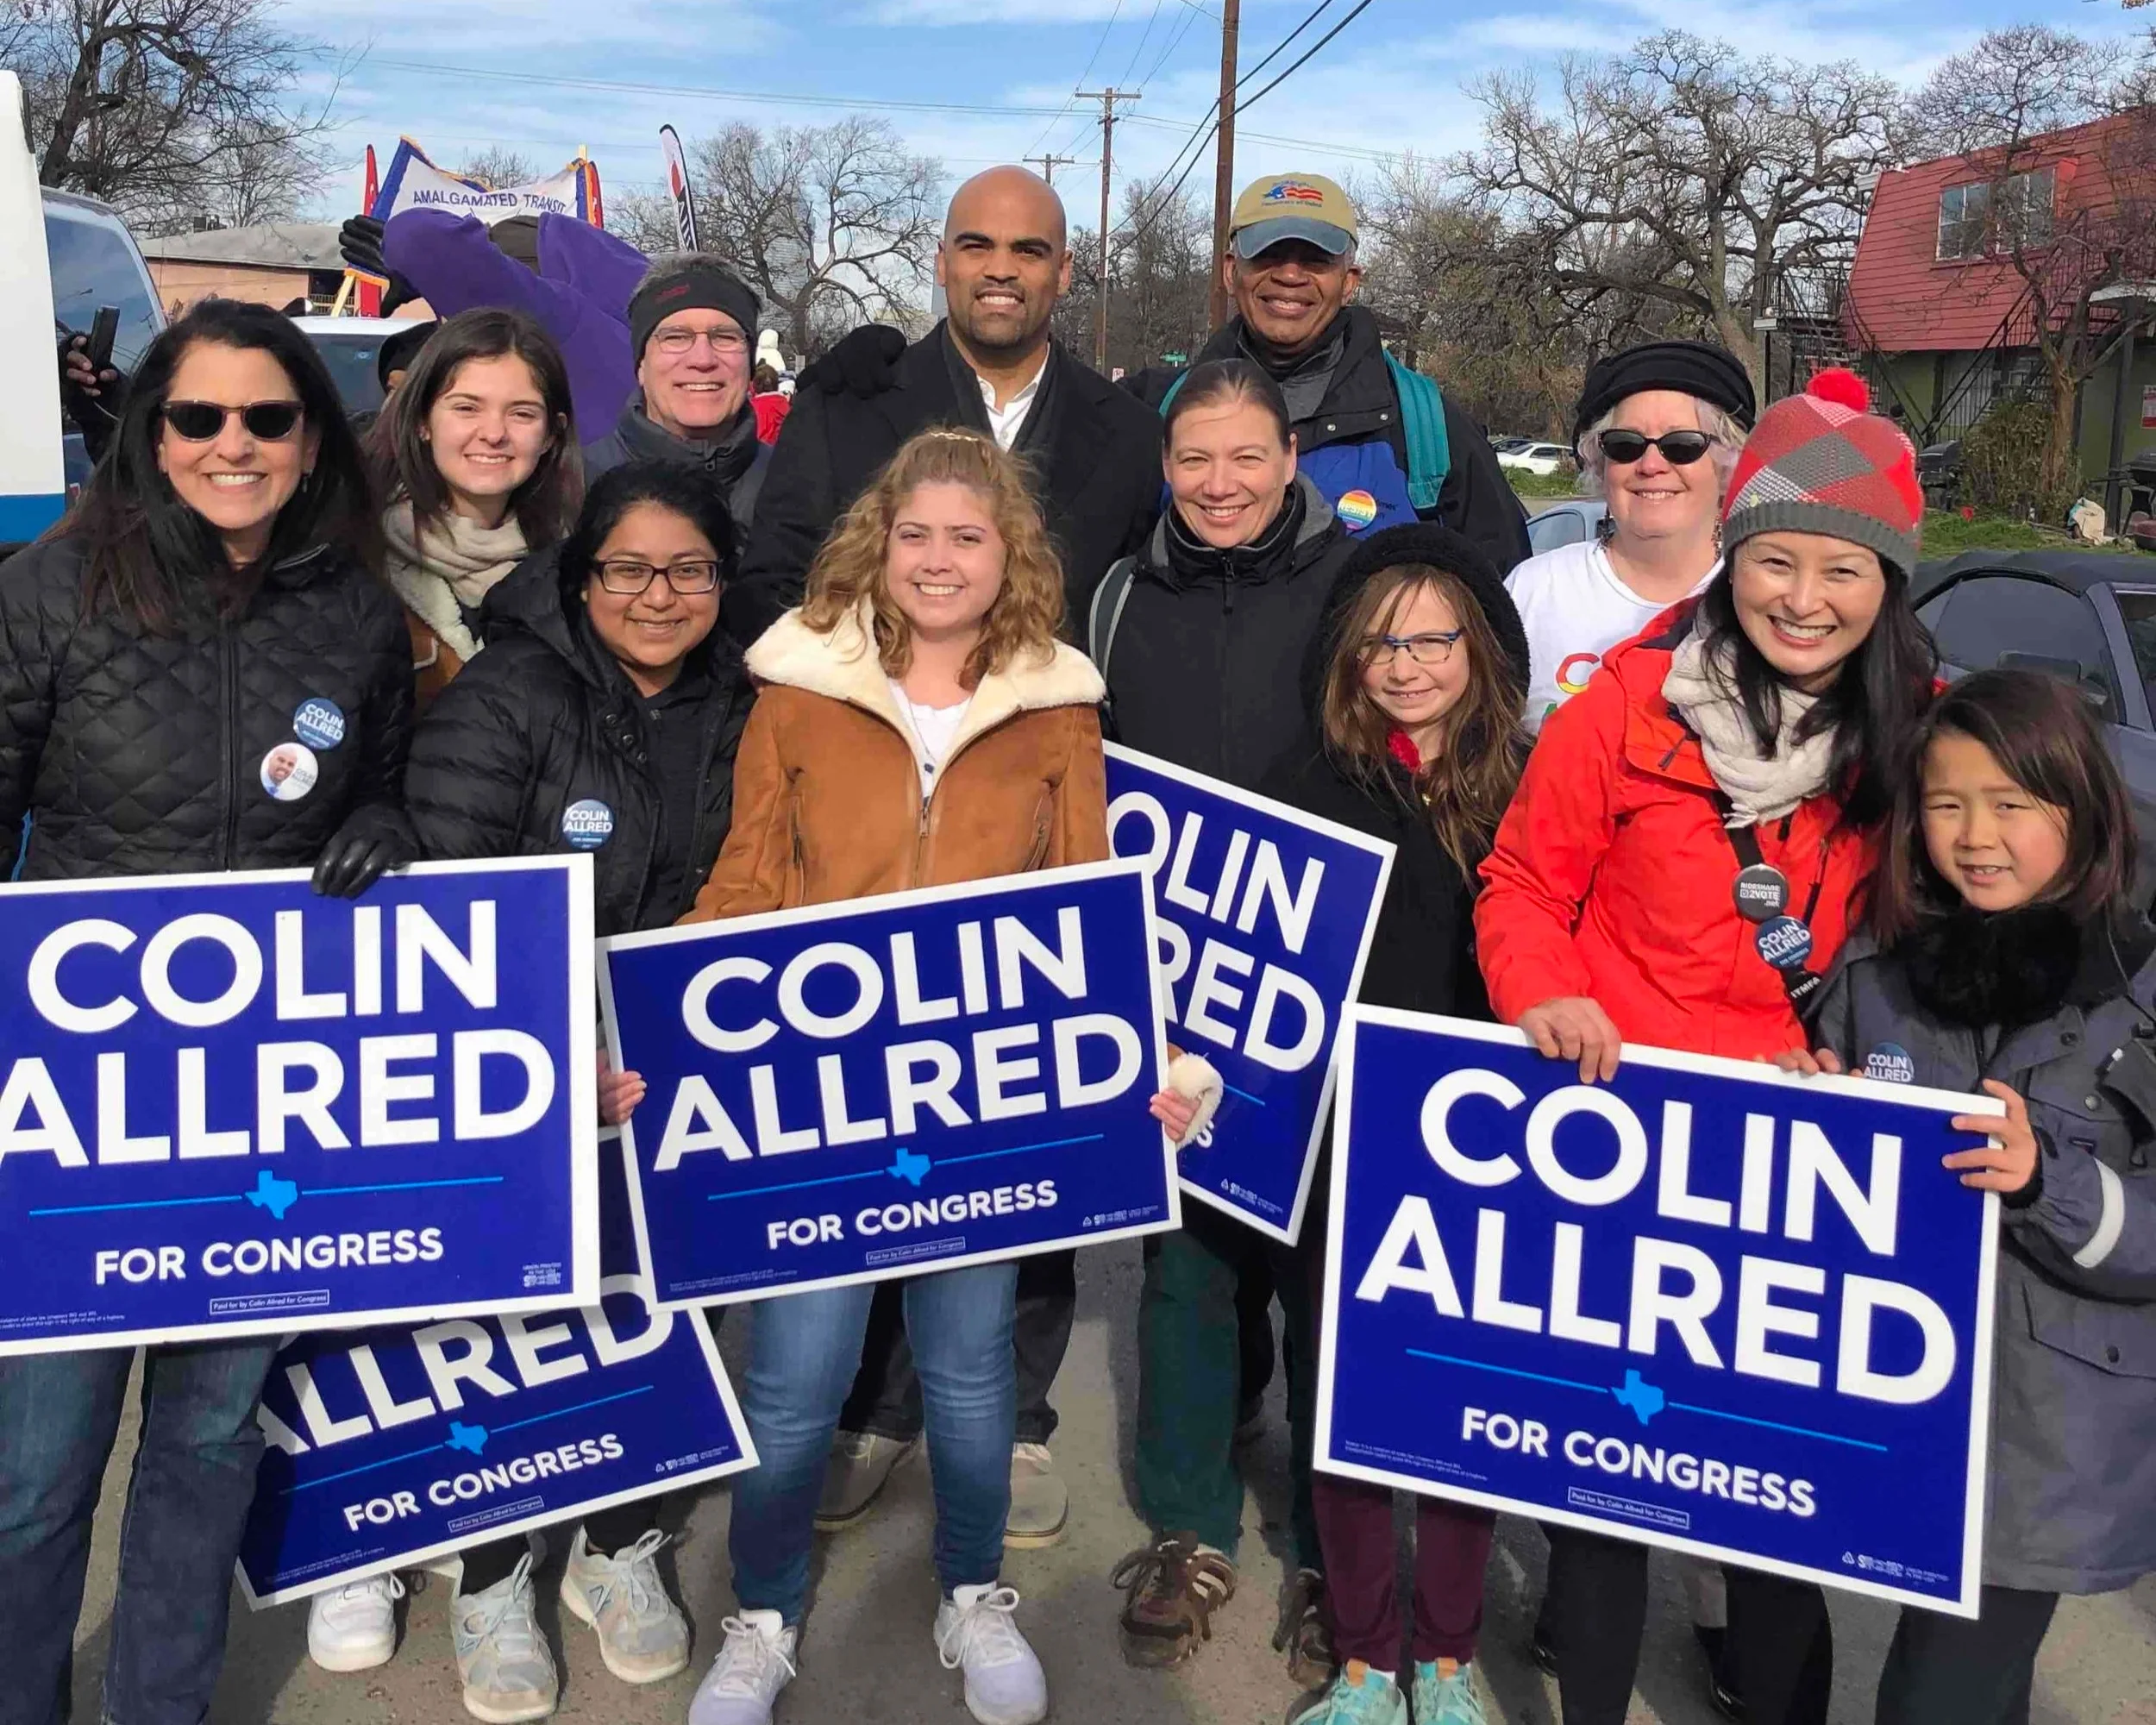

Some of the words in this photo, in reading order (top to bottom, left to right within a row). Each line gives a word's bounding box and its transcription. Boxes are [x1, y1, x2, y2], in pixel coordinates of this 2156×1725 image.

[413, 190, 517, 207] AMALGAMATED
[523, 193, 567, 214] TRANSIT
[297, 712, 344, 741] ALLRED
[304, 703, 344, 729] COLIN
[562, 821, 613, 833] ALLRED
[569, 810, 609, 821] COLIN
[1107, 791, 1326, 955] OLIN
[28, 900, 498, 1034] COLIN
[1758, 920, 1800, 949] COLIN
[1762, 929, 1811, 963] ALLRED
[681, 906, 1087, 1053] COLIN
[1156, 915, 1326, 1072] RED
[654, 1013, 1143, 1172] ALLRED
[1863, 1065, 1912, 1082] ALLRED
[1867, 1053, 1908, 1070] COLIN
[0, 1029, 555, 1168] ALLRED
[1420, 1069, 1902, 1257] COLIN
[768, 1214, 844, 1250] FOR
[856, 1180, 1058, 1236] CONGRESS
[96, 1246, 186, 1285] FOR
[202, 1228, 444, 1276] CONGRESS
[1355, 1195, 1957, 1405] ALLRED
[343, 1491, 422, 1532] FOR
[428, 1433, 624, 1506] CONGRESS
[1462, 1407, 1549, 1458] FOR
[1564, 1432, 1816, 1517] CONGRESS
